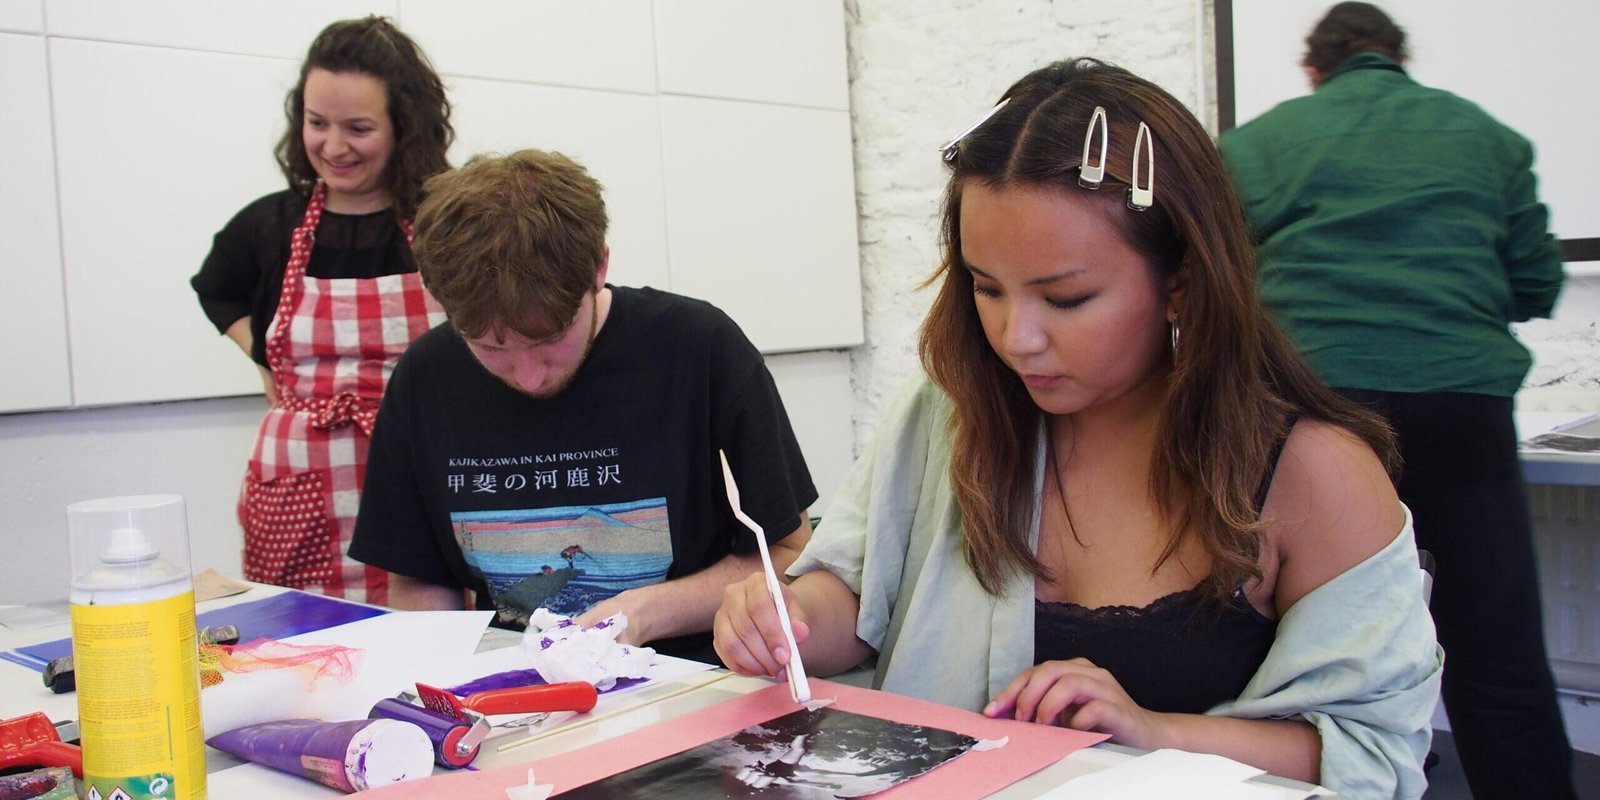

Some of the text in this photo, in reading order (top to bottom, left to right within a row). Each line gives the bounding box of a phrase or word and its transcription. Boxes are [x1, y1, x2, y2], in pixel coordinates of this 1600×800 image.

[449, 447, 619, 467] KAJIKAZAWA IN KAI PROVINCE
[447, 464, 622, 494] 甲斐の河鹿沢
